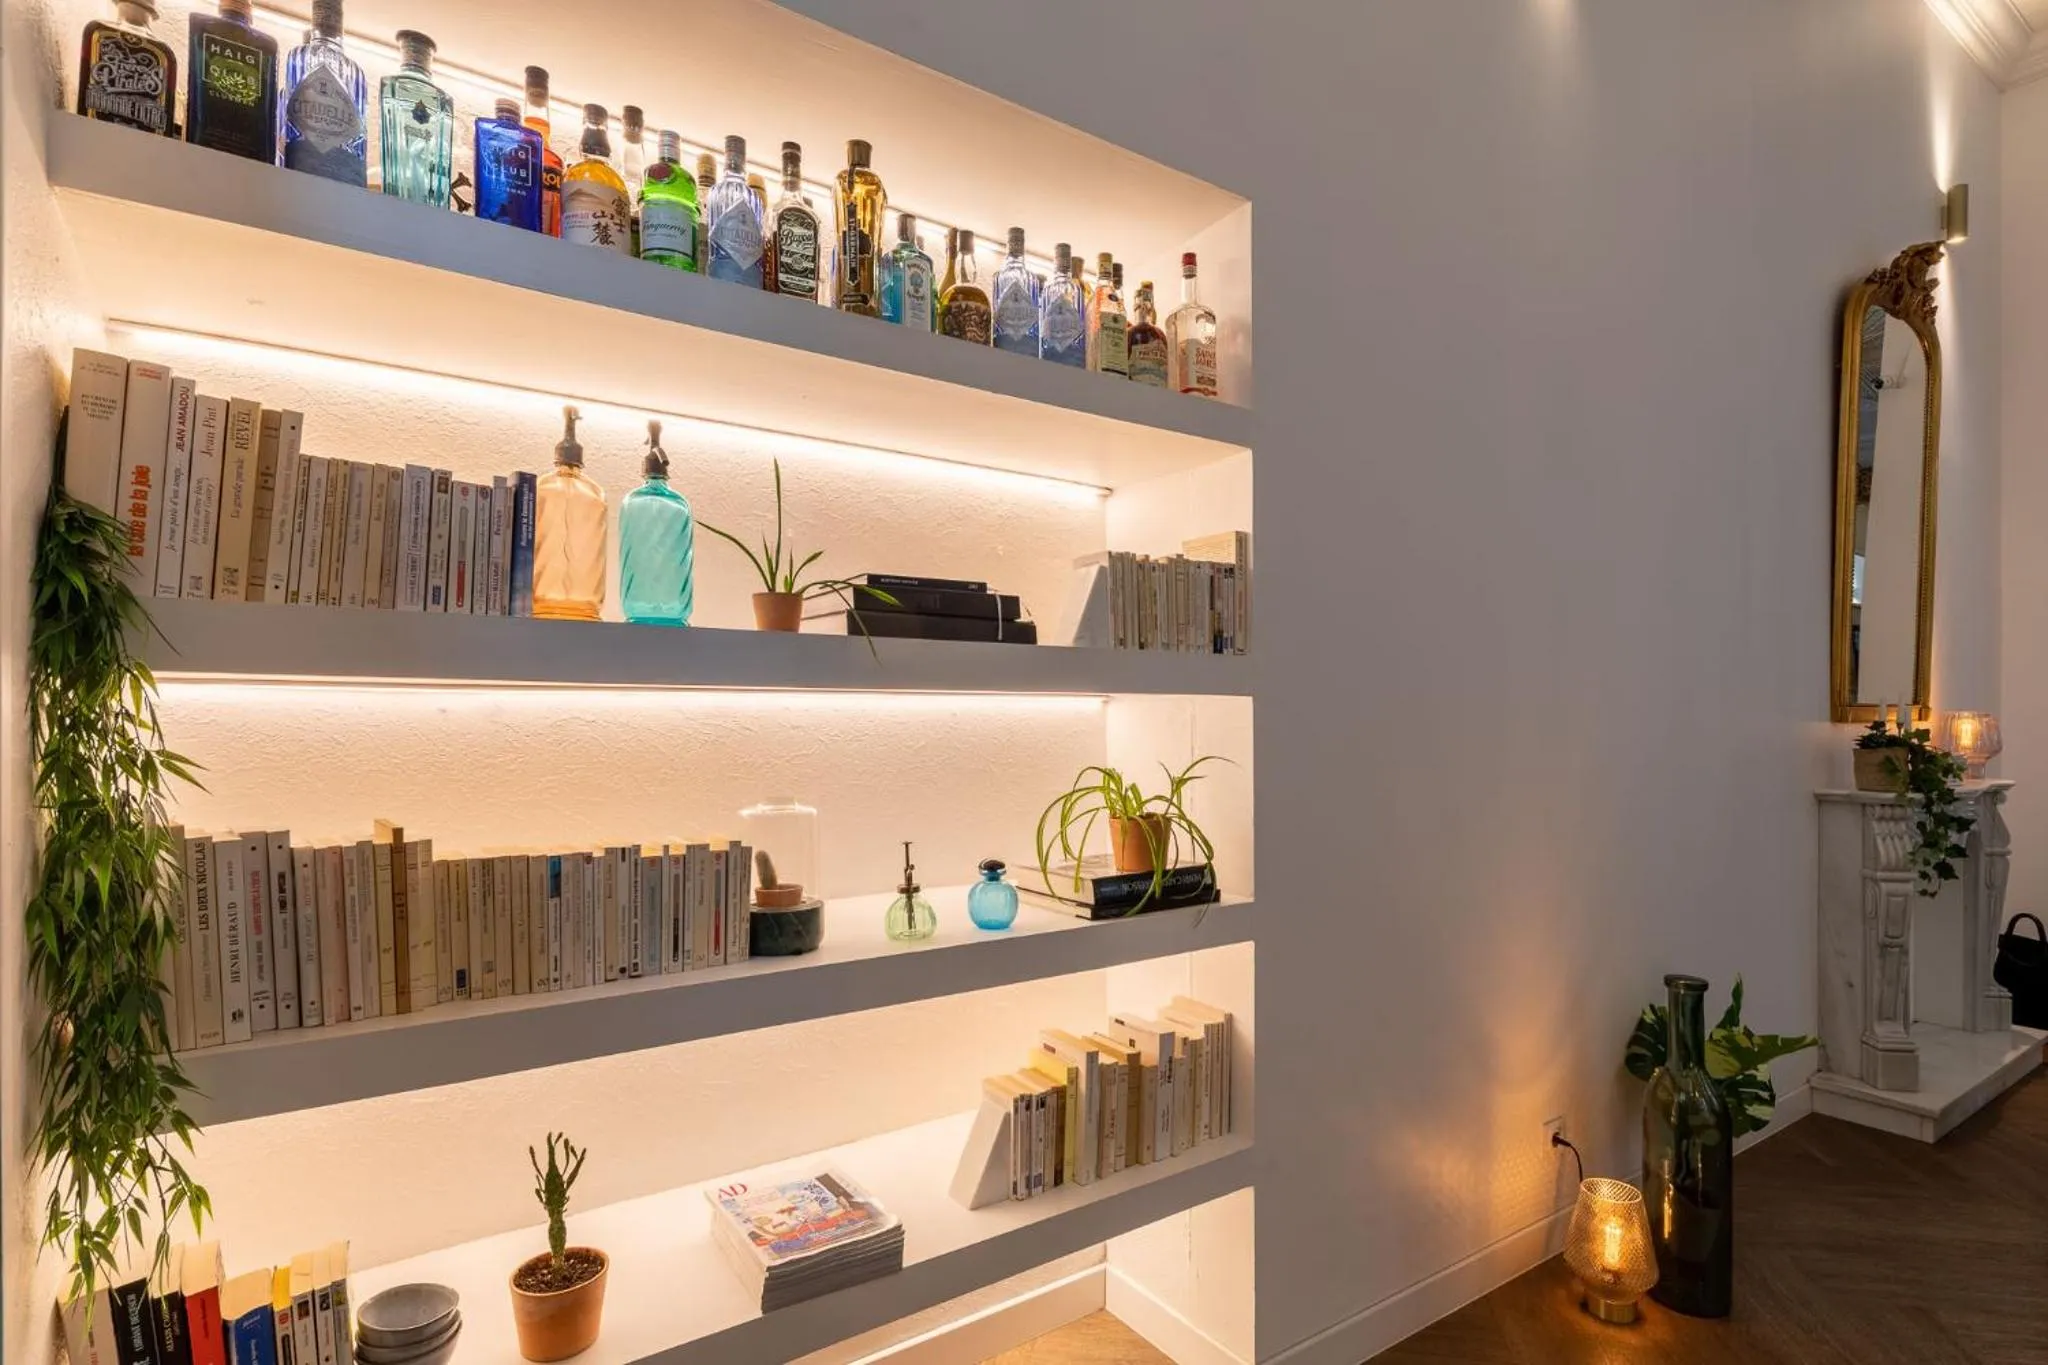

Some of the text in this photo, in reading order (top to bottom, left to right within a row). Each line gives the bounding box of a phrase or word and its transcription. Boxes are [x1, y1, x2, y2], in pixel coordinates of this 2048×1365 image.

[210, 43, 255, 65] HAIG
[176, 386, 190, 452] JEAN AMADOU
[235, 411, 251, 450] REVEL
[200, 432, 214, 457] Jean
[133, 465, 151, 488] joie
[131, 489, 149, 501] la
[130, 502, 147, 518] de
[194, 841, 207, 886] NICOLAS
[196, 887, 209, 911] DEUX
[198, 913, 210, 931] LES
[227, 902, 239, 946] BÉRAUD
[229, 949, 241, 983] HENRI
[718, 1183, 748, 1200] AD
